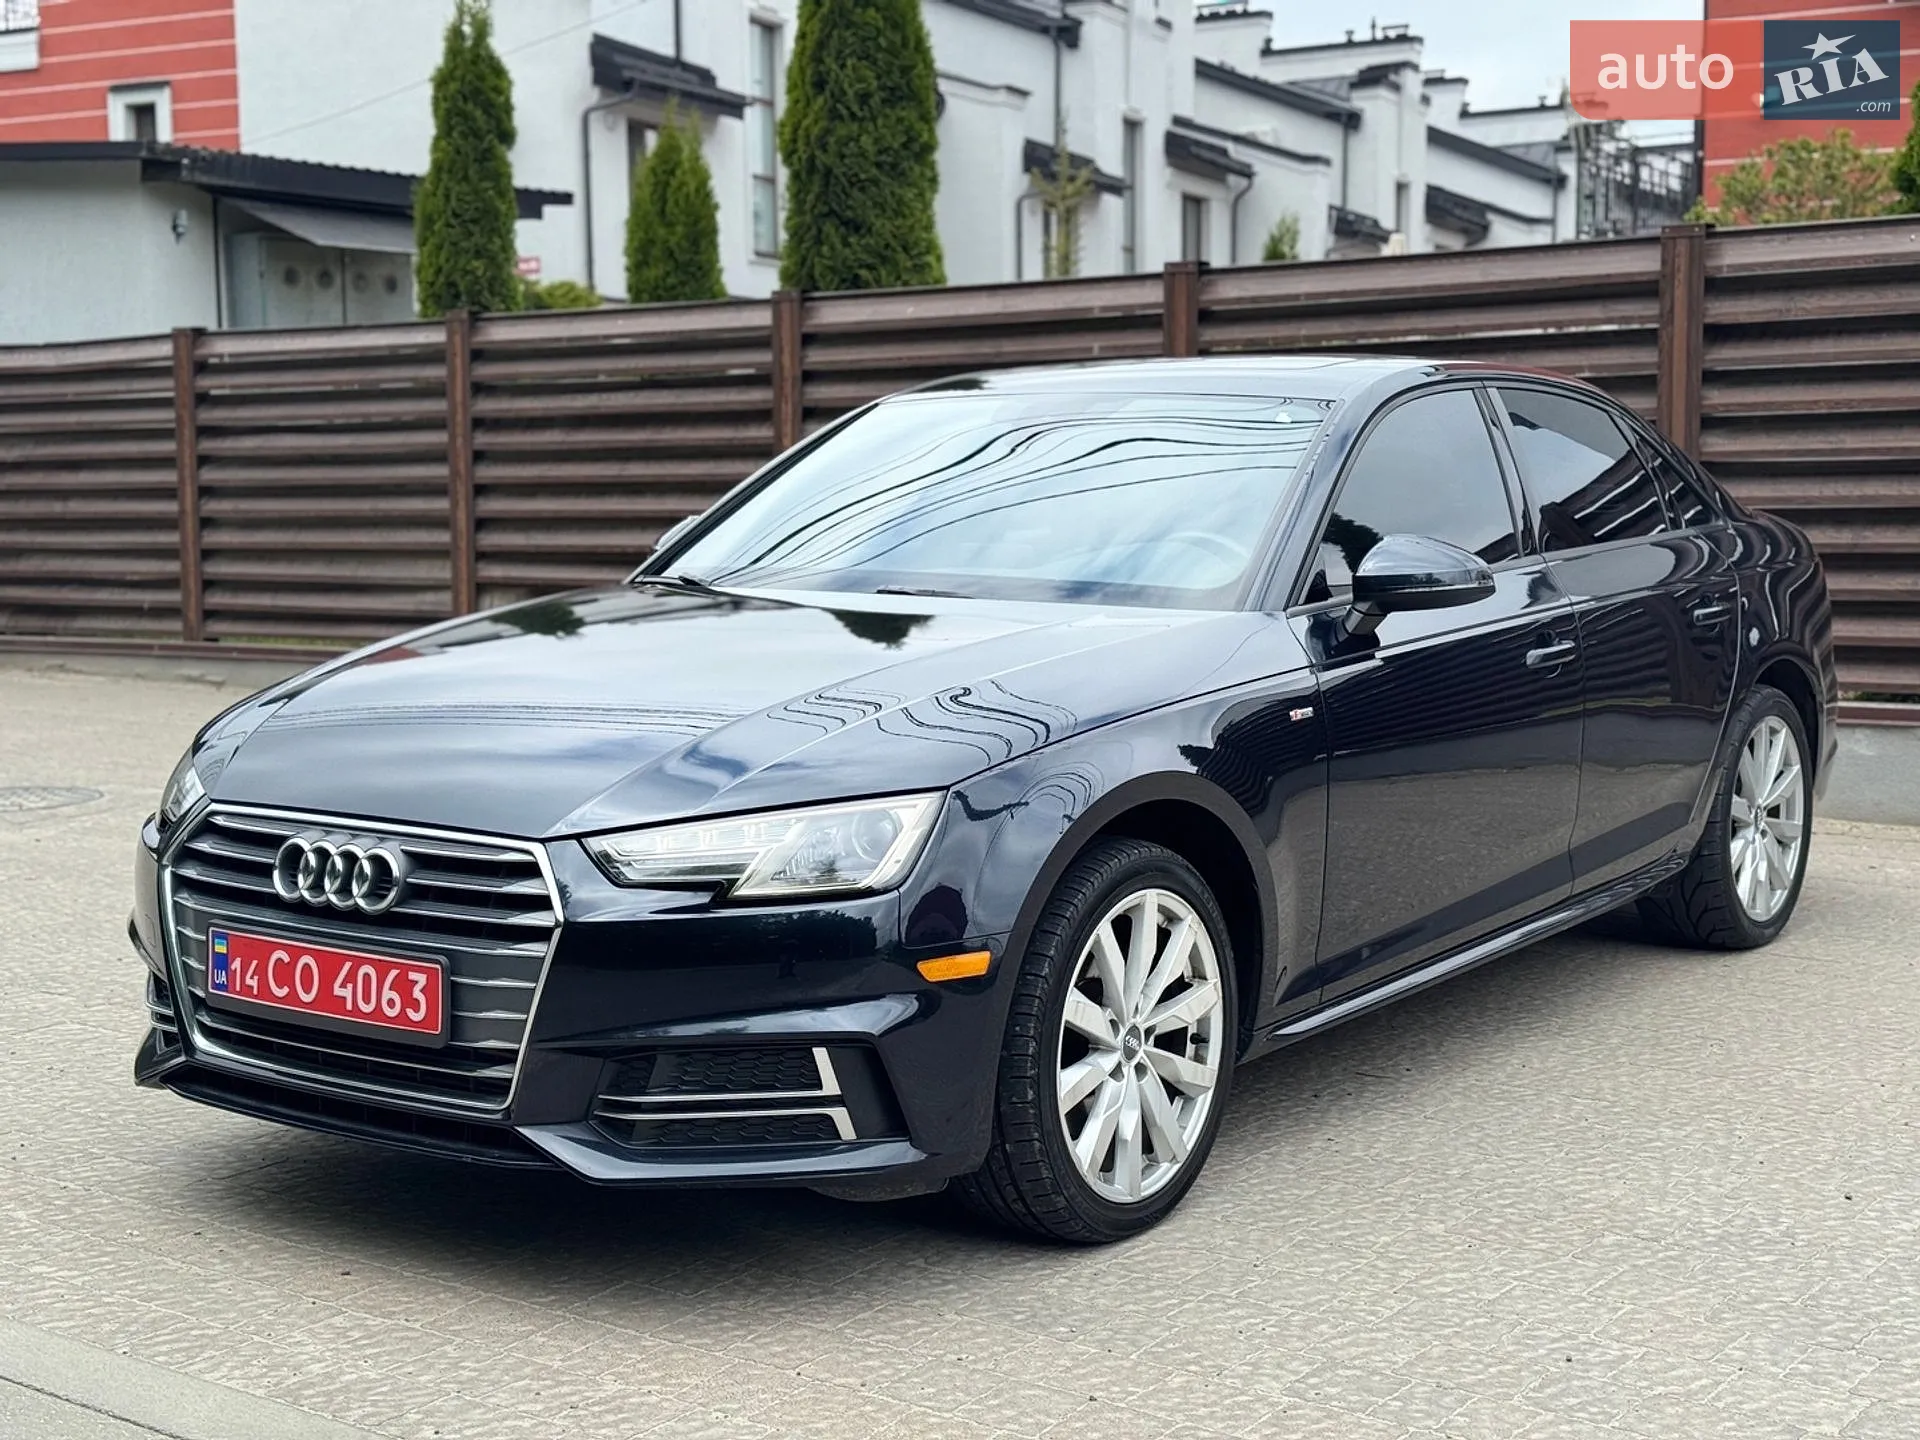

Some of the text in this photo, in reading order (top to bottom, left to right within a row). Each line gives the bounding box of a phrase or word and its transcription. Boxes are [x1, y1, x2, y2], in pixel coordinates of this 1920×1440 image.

[214, 969, 227, 985] UA
[230, 949, 428, 1022] 14 CO 4063
